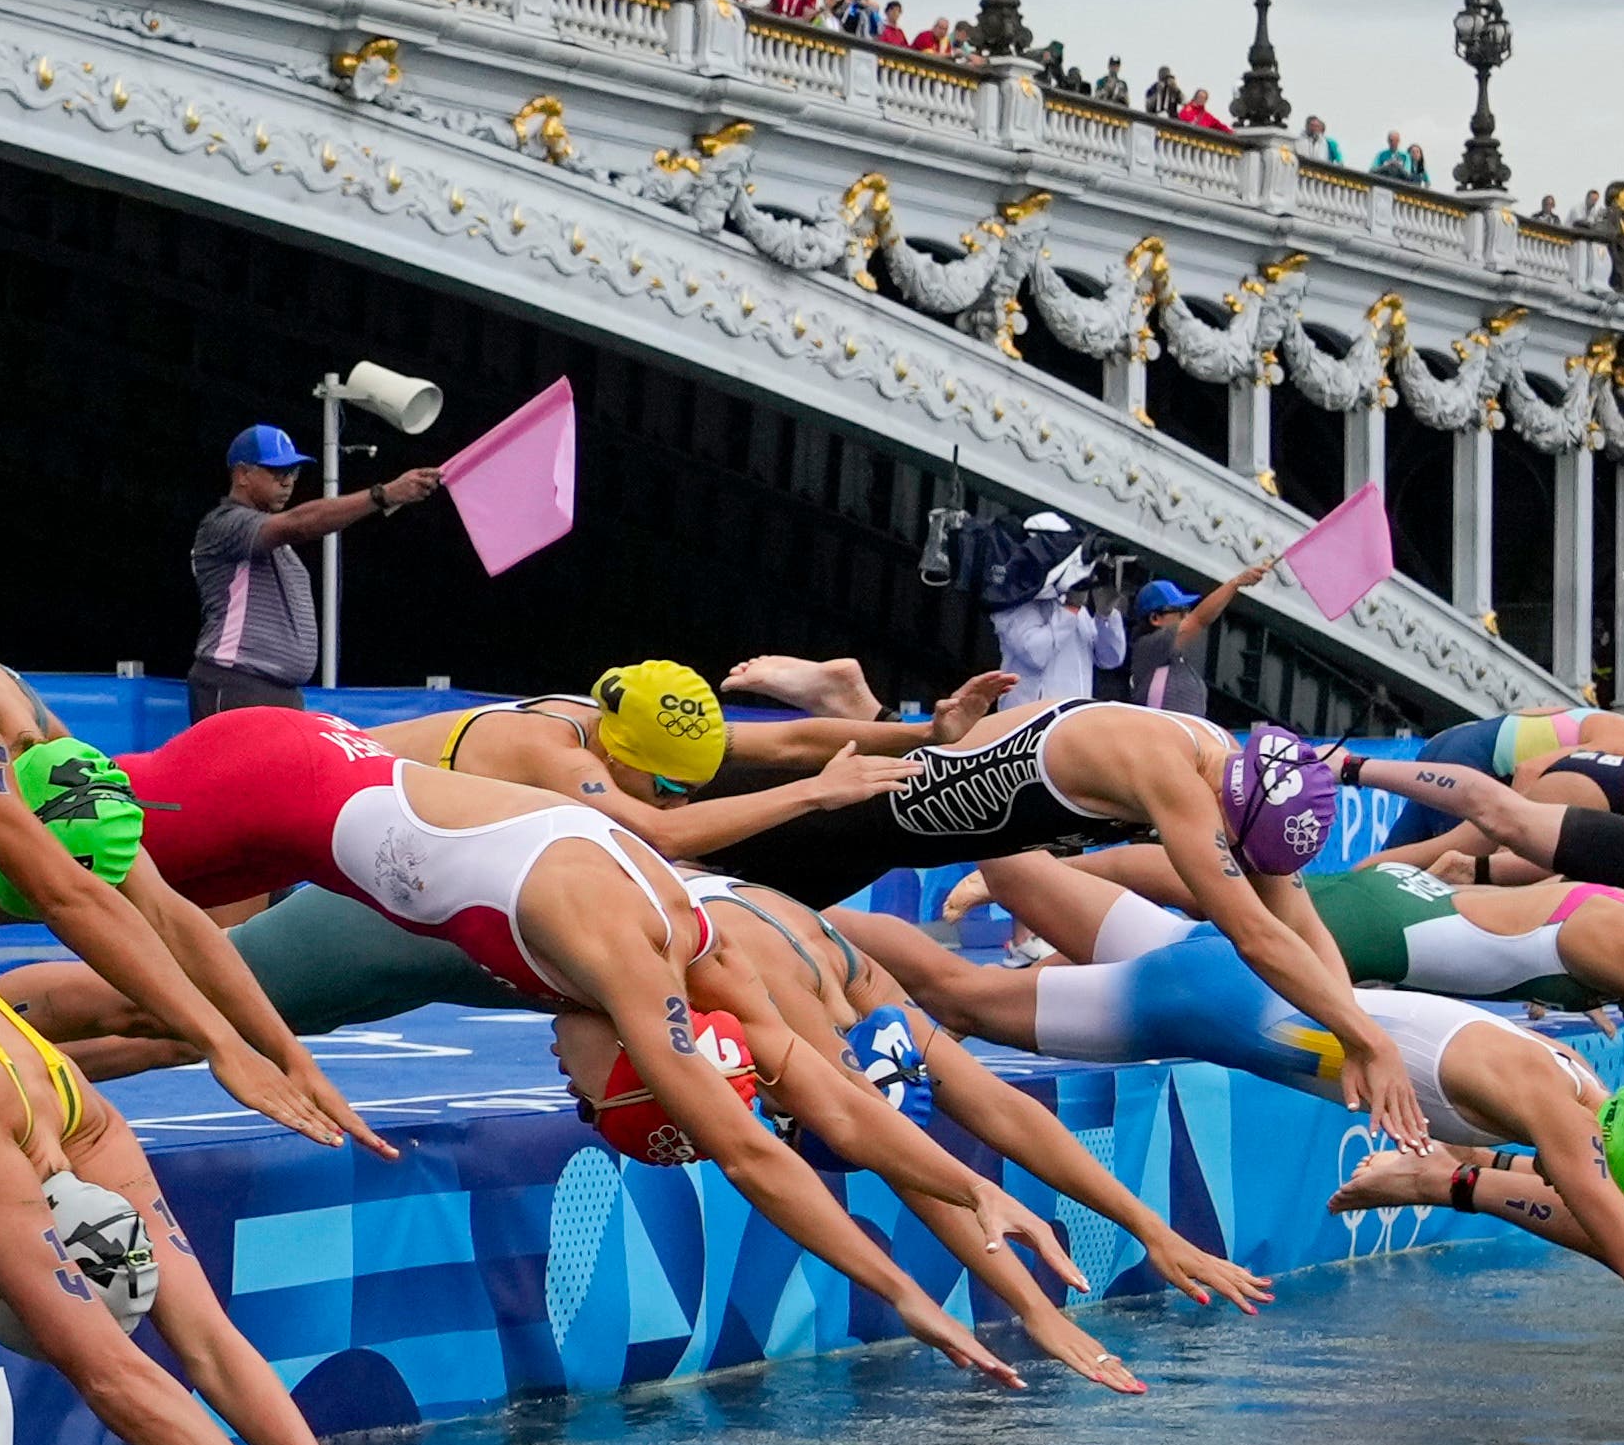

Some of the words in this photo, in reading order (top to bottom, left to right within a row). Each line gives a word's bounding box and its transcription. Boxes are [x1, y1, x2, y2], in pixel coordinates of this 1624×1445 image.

[660, 693, 706, 717] COL
[1258, 734, 1304, 806] 53
[664, 996, 696, 1055] 28
[42, 1225, 94, 1302] 14
